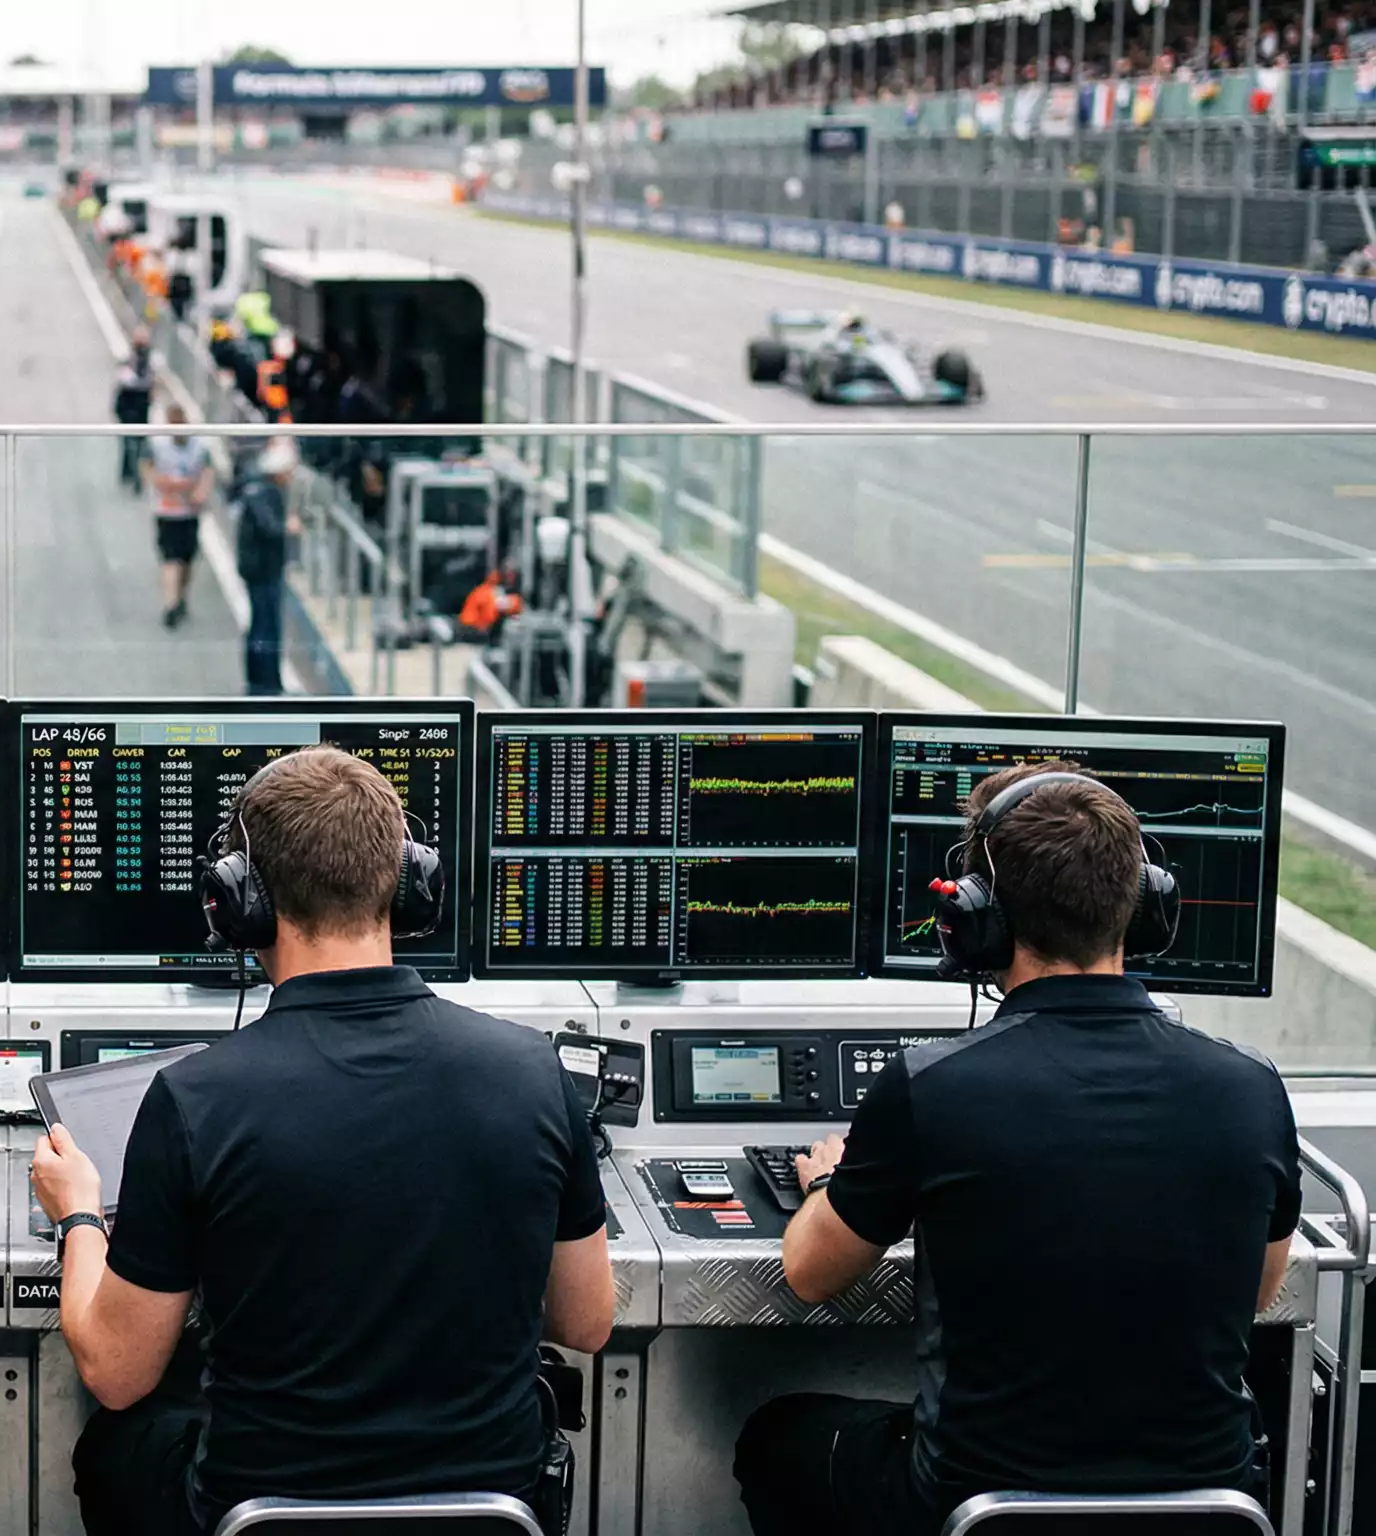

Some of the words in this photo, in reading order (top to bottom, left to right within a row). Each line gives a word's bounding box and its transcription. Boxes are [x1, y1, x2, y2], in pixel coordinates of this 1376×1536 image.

[33, 728, 59, 741] LAP
[63, 727, 106, 743] 48/66
[33, 748, 51, 757] POS
[168, 749, 185, 757] CAR
[223, 749, 241, 757] GAP
[266, 748, 282, 757] INT
[351, 748, 374, 757] LAPS
[18, 1285, 60, 1298] DATA
